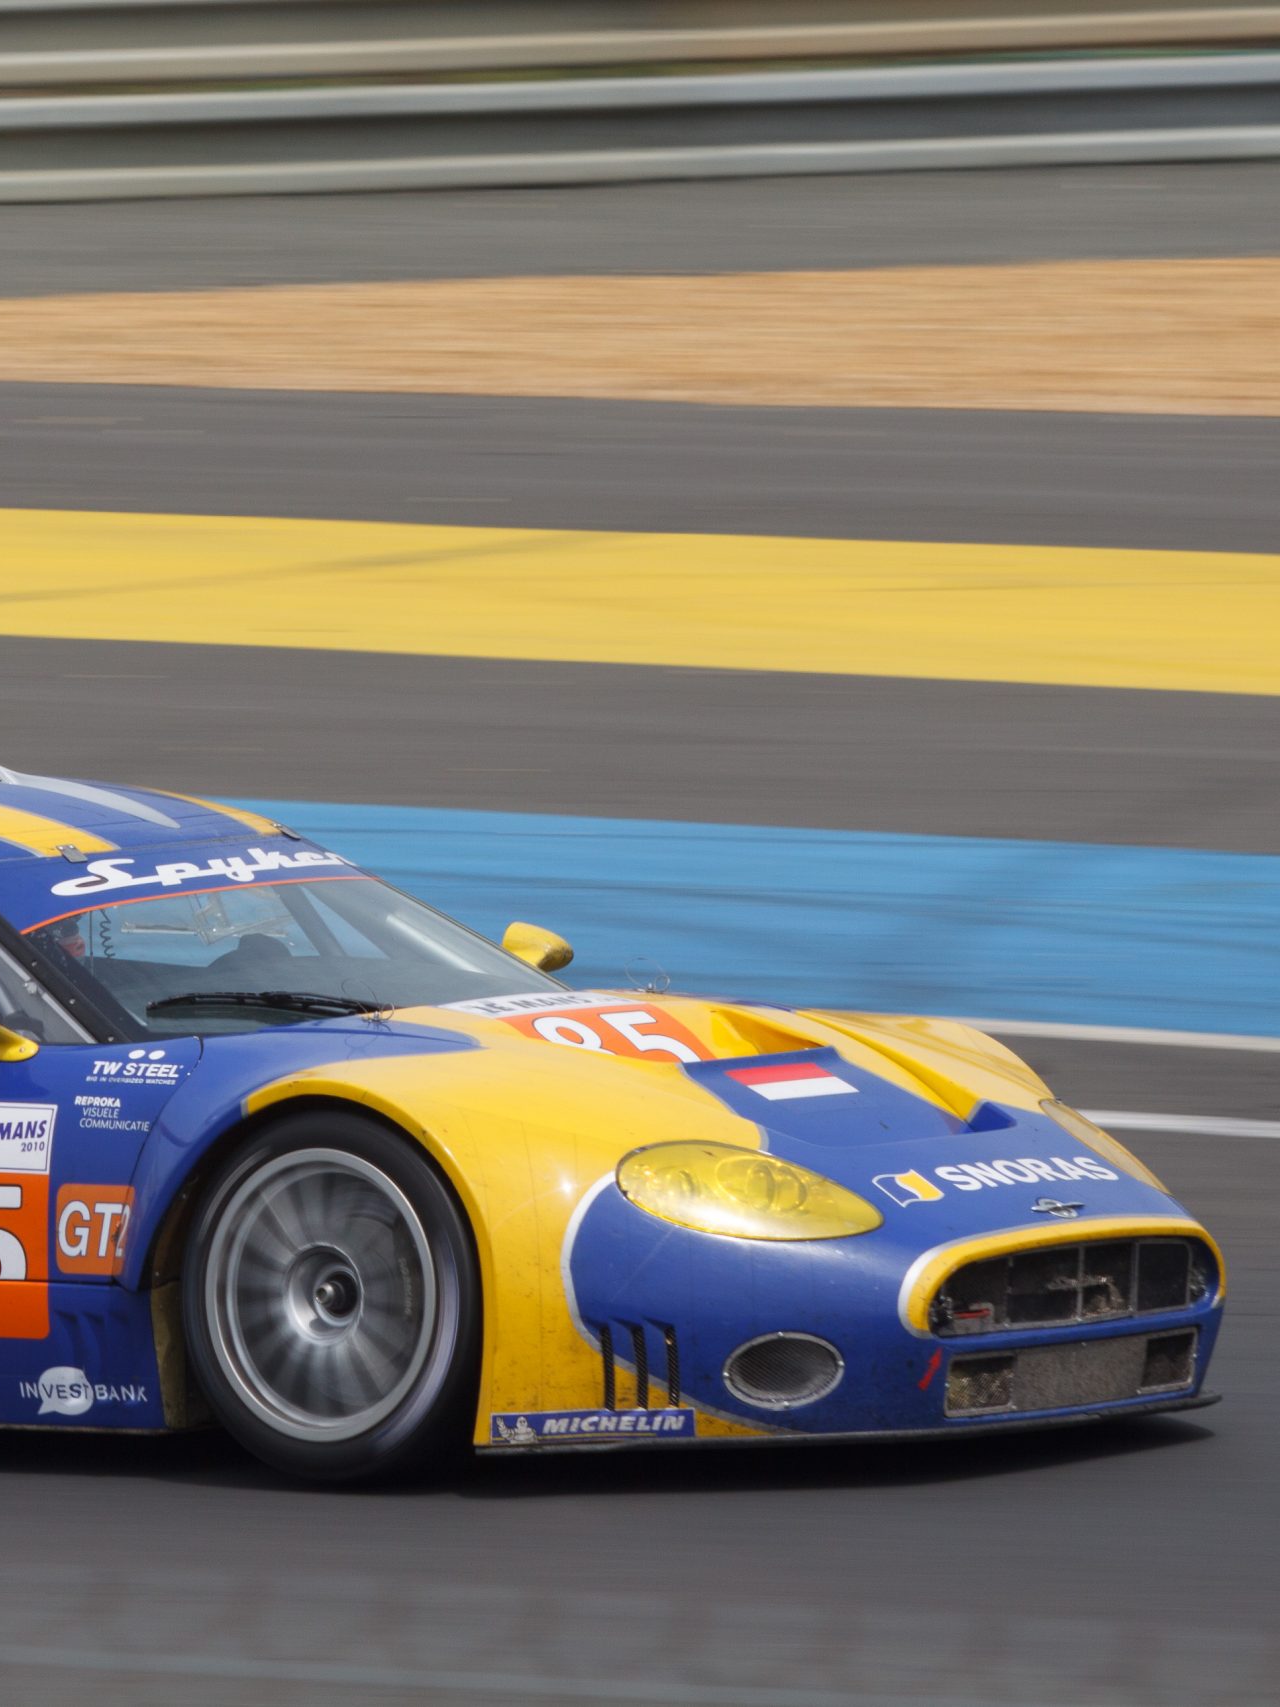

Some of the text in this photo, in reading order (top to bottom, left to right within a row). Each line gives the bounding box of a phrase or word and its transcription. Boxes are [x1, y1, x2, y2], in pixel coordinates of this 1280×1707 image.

[51, 848, 357, 896] Spyker
[93, 1061, 179, 1078] TW STEEL
[74, 1095, 121, 1108] REPROKA
[82, 1107, 120, 1119] VISUELE
[79, 1118, 150, 1132] COMMUNICATIE
[21, 1141, 46, 1153] 2010
[934, 1156, 1119, 1192] SNORAS
[58, 1200, 131, 1258] GT2
[542, 1415, 686, 1434] MICHELIN
